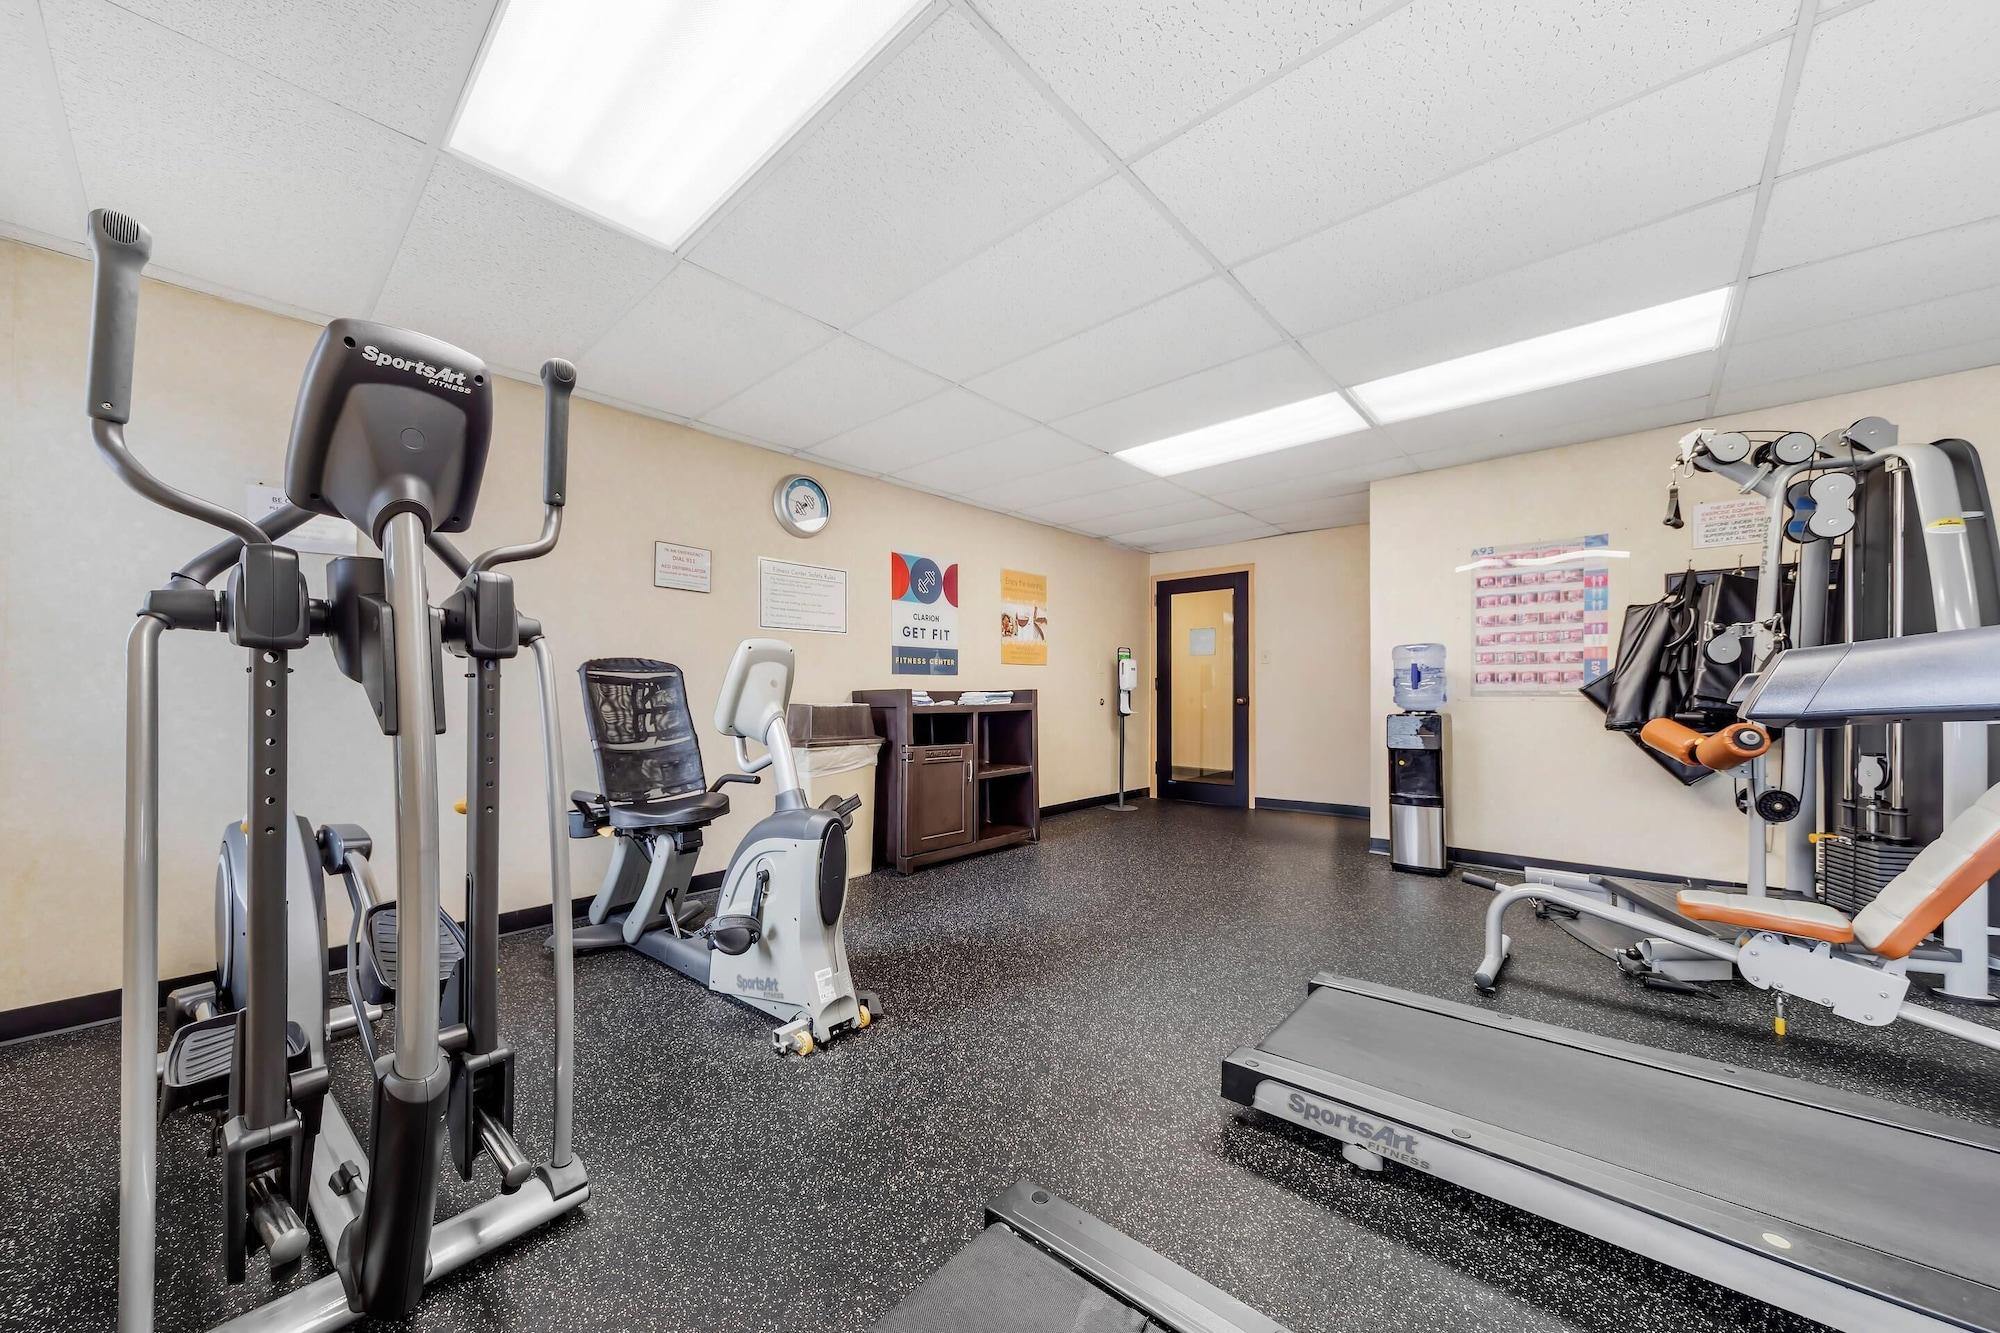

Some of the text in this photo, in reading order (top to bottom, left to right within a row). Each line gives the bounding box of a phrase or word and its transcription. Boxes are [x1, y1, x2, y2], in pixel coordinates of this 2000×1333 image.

[361, 344, 467, 386] SportsArt
[427, 378, 473, 395] FITNESS
[1471, 546, 1495, 557] A93
[912, 613, 940, 622] CLARION
[902, 625, 950, 641] GET FIT
[895, 656, 955, 666] FITNESS CENTER
[736, 973, 779, 993] SportsArt
[1288, 1092, 1419, 1156] SportsArt
[1367, 1141, 1431, 1170] FITNESS
